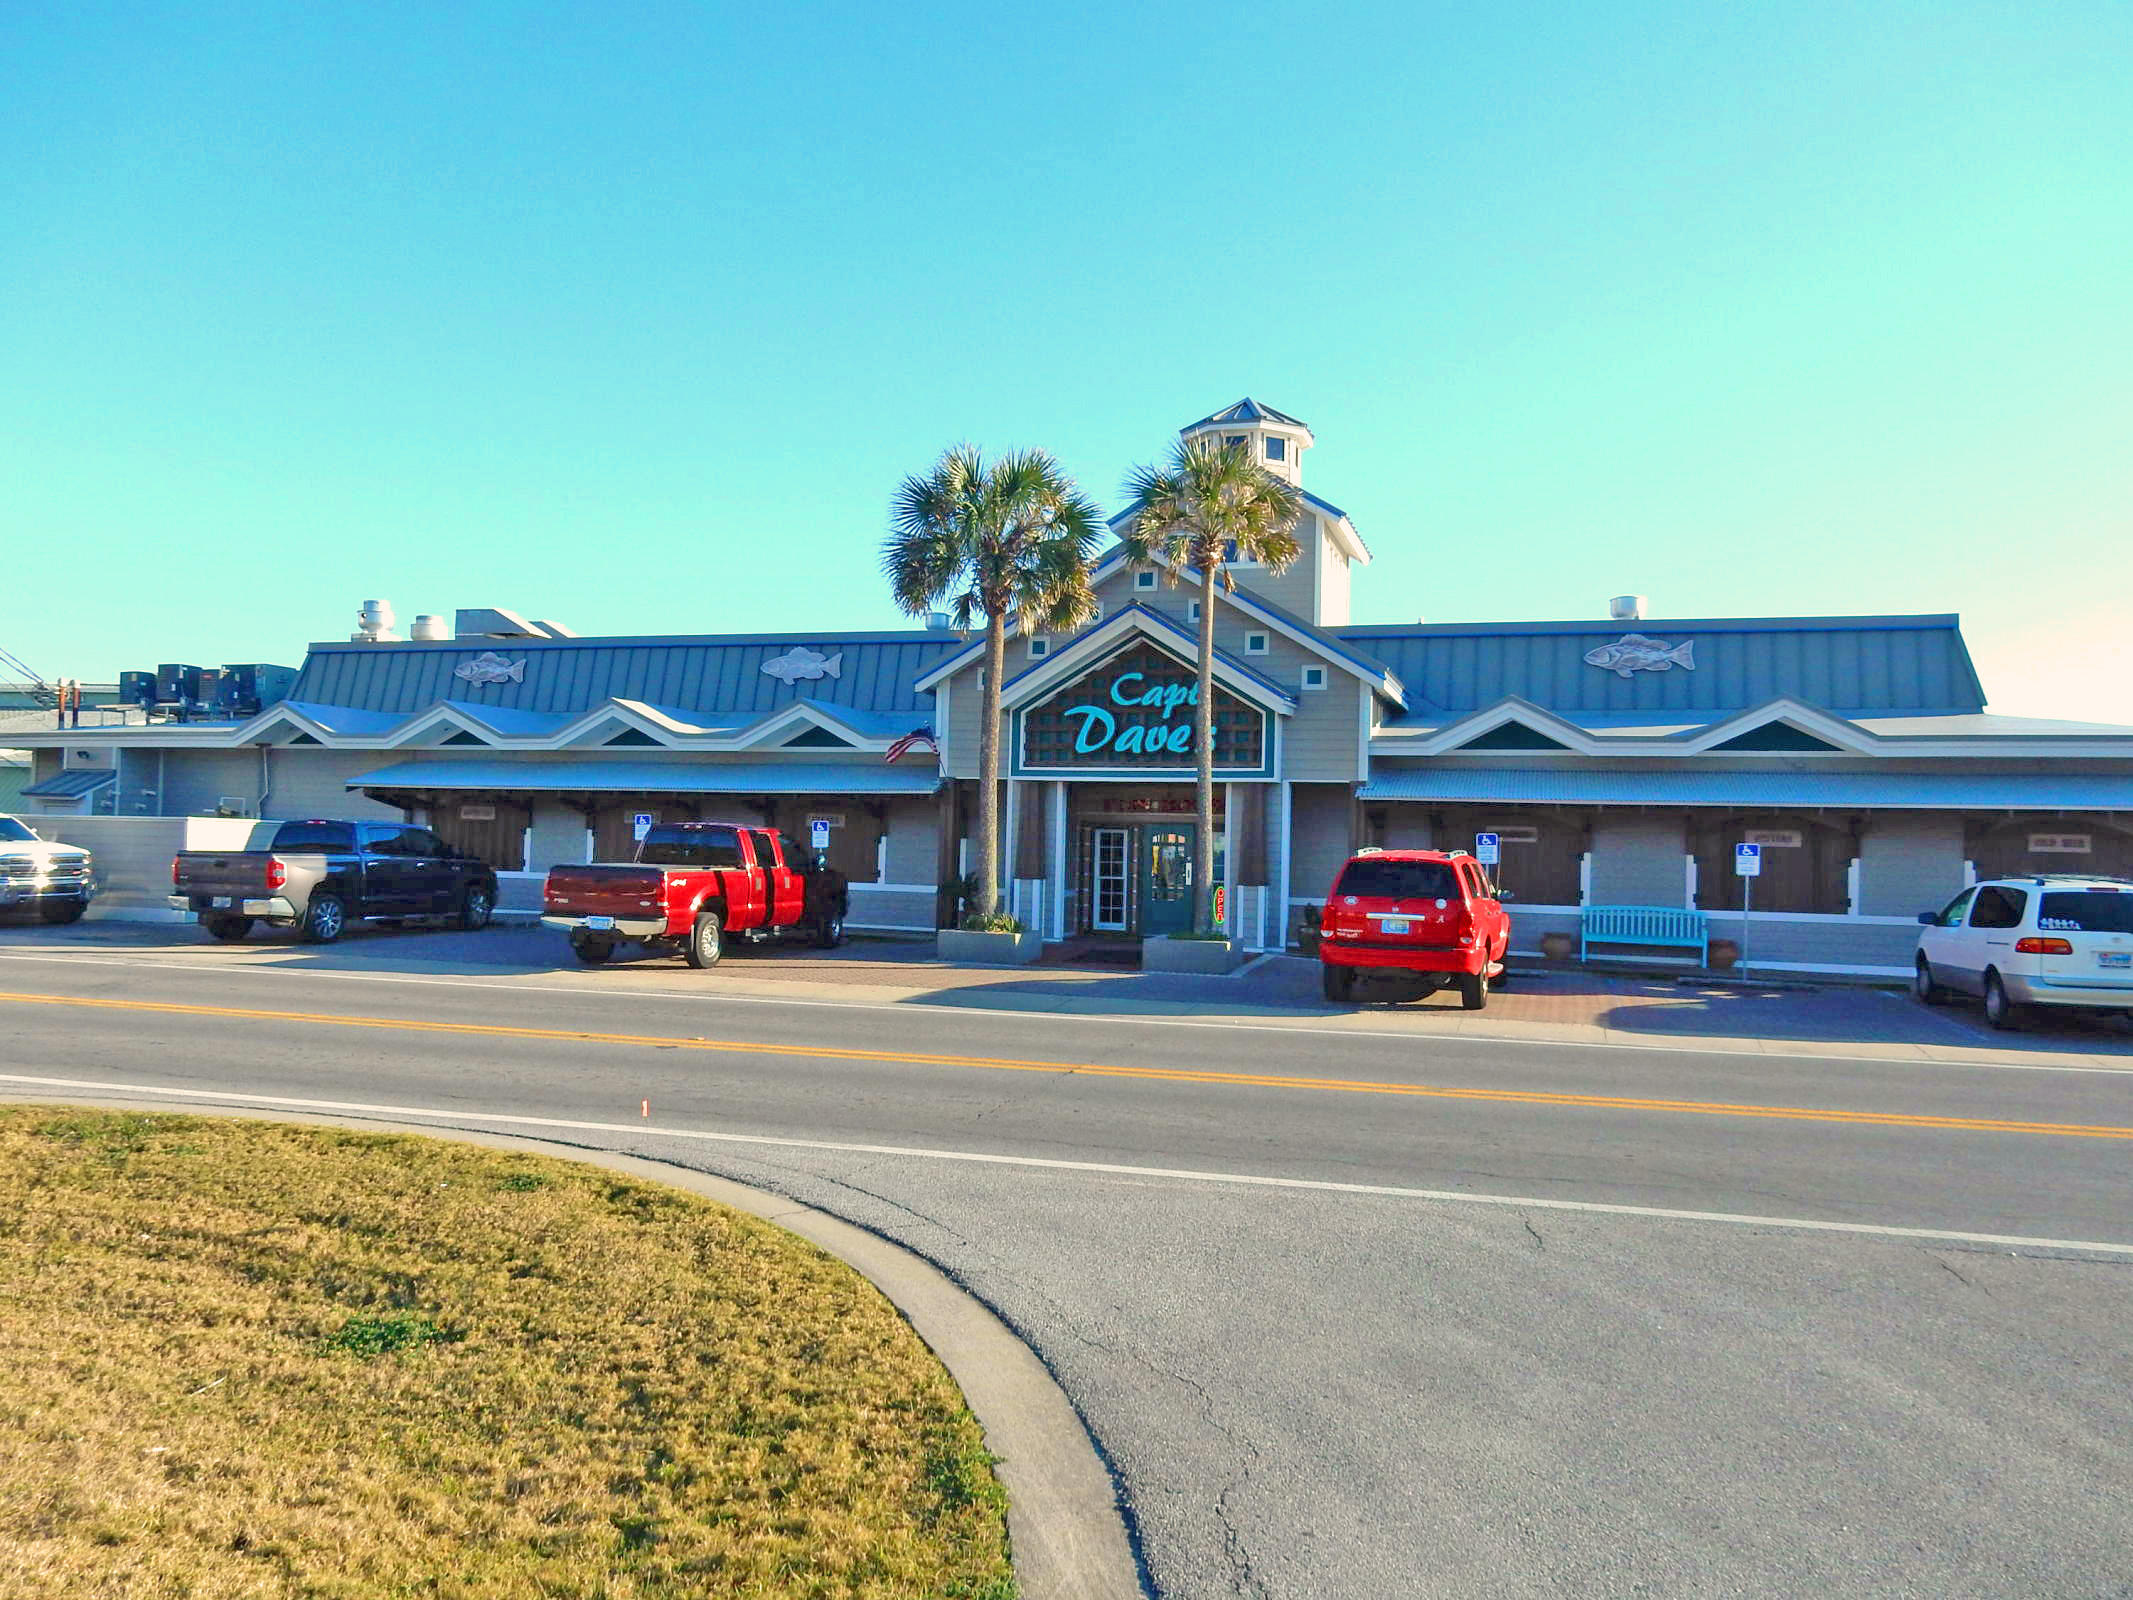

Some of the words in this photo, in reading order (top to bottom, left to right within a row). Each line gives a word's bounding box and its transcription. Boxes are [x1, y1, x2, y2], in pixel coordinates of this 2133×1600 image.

[1110, 672, 1199, 719] Capt
[1064, 705, 1217, 754] Dave
[1217, 888, 1225, 921] OPEN
